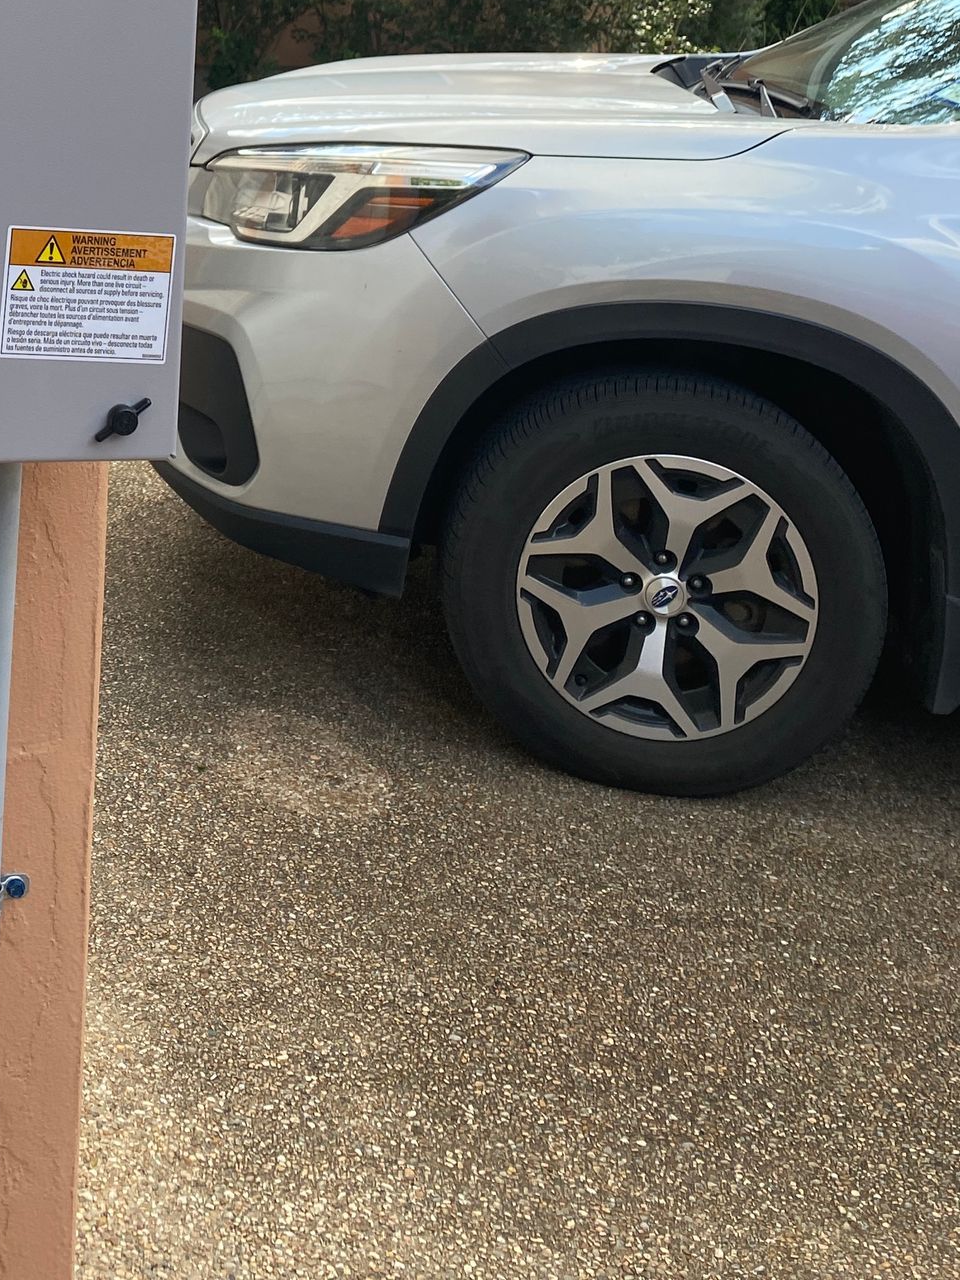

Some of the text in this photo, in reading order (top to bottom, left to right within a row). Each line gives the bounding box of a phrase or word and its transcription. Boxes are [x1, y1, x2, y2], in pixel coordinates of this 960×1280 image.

[71, 234, 117, 246] WARNING
[70, 246, 148, 259] AVERTISSEMENT
[69, 257, 136, 269] ADVERTENCIA
[40, 269, 61, 278] Electric
[62, 270, 77, 279] shock
[78, 271, 96, 280] hazard
[97, 272, 111, 280] could
[112, 273, 127, 281] result
[133, 274, 148, 282] death
[77, 279, 91, 287] More
[39, 286, 68, 294] disconnect
[76, 287, 97, 295] sources
[104, 289, 121, 297] supply
[121, 289, 138, 297] before
[10, 294, 28, 303] Risque
[37, 295, 50, 303] choc
[137, 300, 162, 308] blessures
[64, 304, 76, 312] Plus
[7, 328, 25, 337] Riesgo
[93, 332, 109, 340] puede
[15, 344, 34, 352] fuentes
